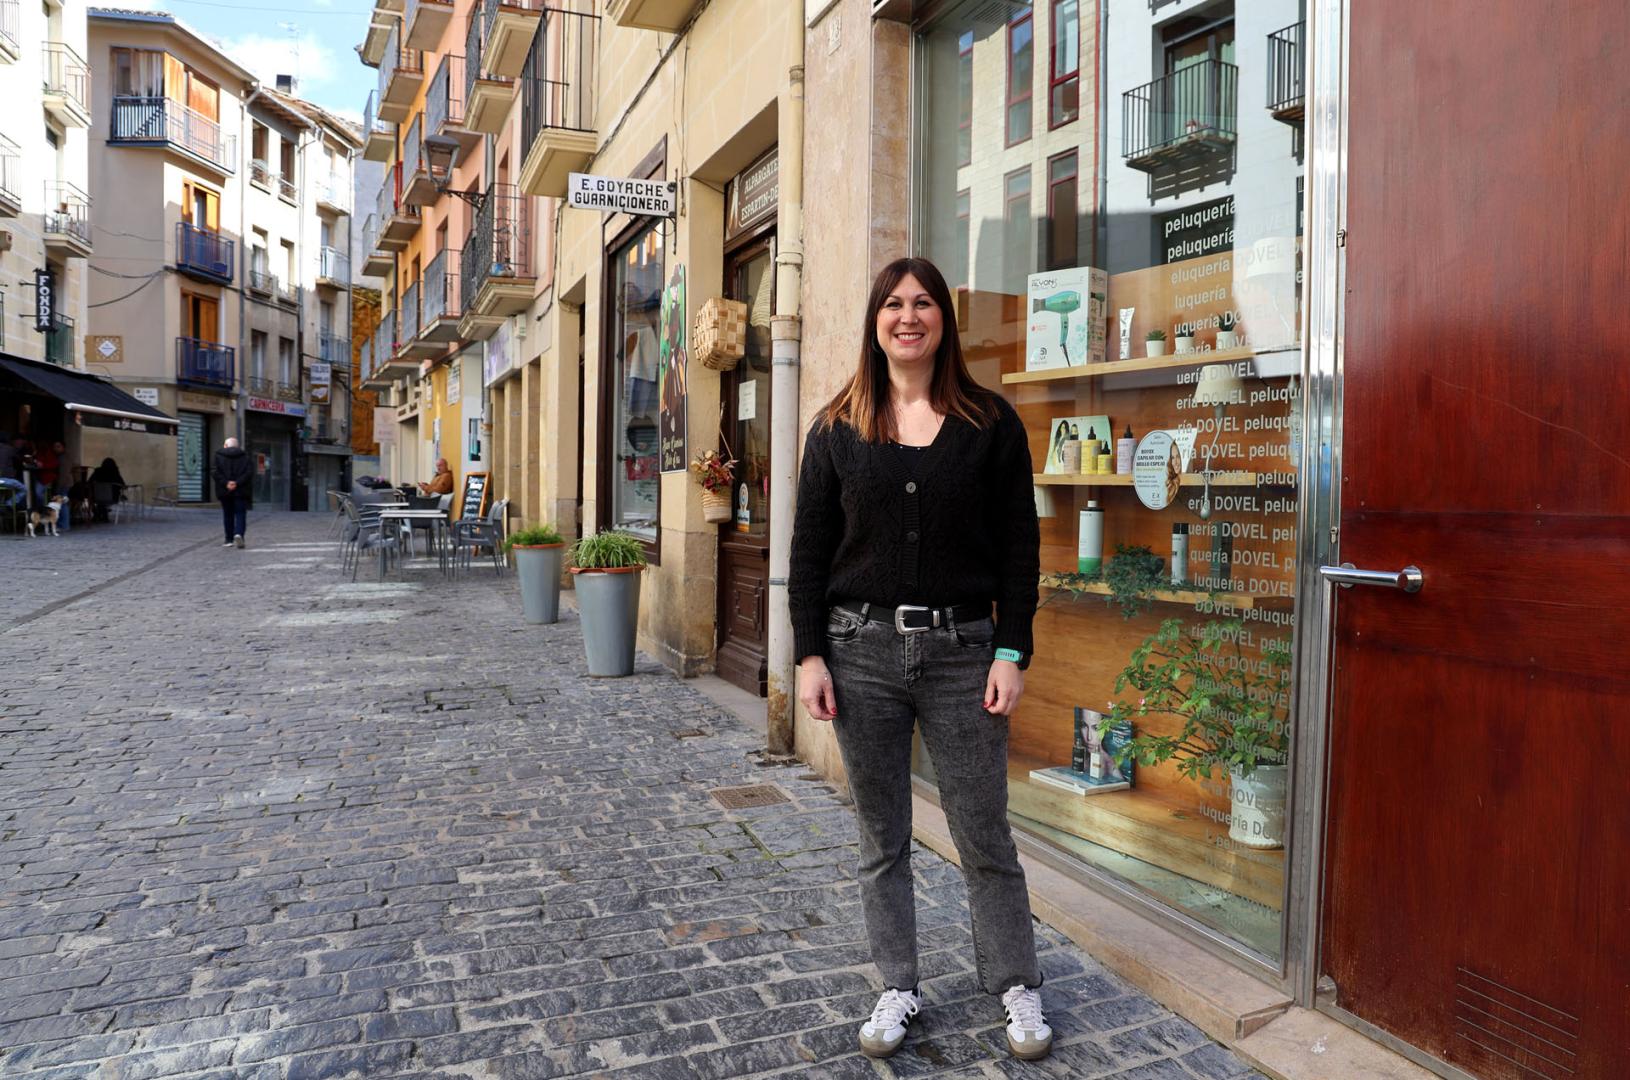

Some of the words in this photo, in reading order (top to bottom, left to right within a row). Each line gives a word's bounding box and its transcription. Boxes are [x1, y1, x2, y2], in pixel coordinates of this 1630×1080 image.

[582, 179, 593, 191] E.
[597, 180, 664, 197] GOYACHE
[575, 192, 669, 211] GUARNICIONERO
[1165, 197, 1237, 239] peluquería
[1167, 227, 1235, 263] peluquería
[1171, 256, 1230, 284] eluquería
[39, 275, 50, 326] FONDA
[1175, 284, 1226, 309] luquería
[1174, 312, 1219, 336] uquería
[1210, 361, 1255, 379] DOVEL
[1202, 388, 1246, 407] DOVEL
[1196, 416, 1240, 433] DOVEL
[1201, 442, 1245, 459] DOVEL
[1214, 495, 1260, 512] DOVEL
[1188, 520, 1218, 537] uería
[1221, 522, 1268, 540] DOVEL
[1190, 548, 1228, 564] quería
[1232, 549, 1280, 569] DOVEL
[1194, 572, 1244, 592] luquería
[1249, 578, 1296, 597] DOVEL
[1195, 598, 1239, 618] DOVEL
[1211, 626, 1256, 648] DOVEL
[1230, 656, 1276, 678] DOVEL
[1248, 686, 1291, 709] DOVE
[1227, 785, 1266, 812] DOVE
[1199, 800, 1248, 831] luquería
